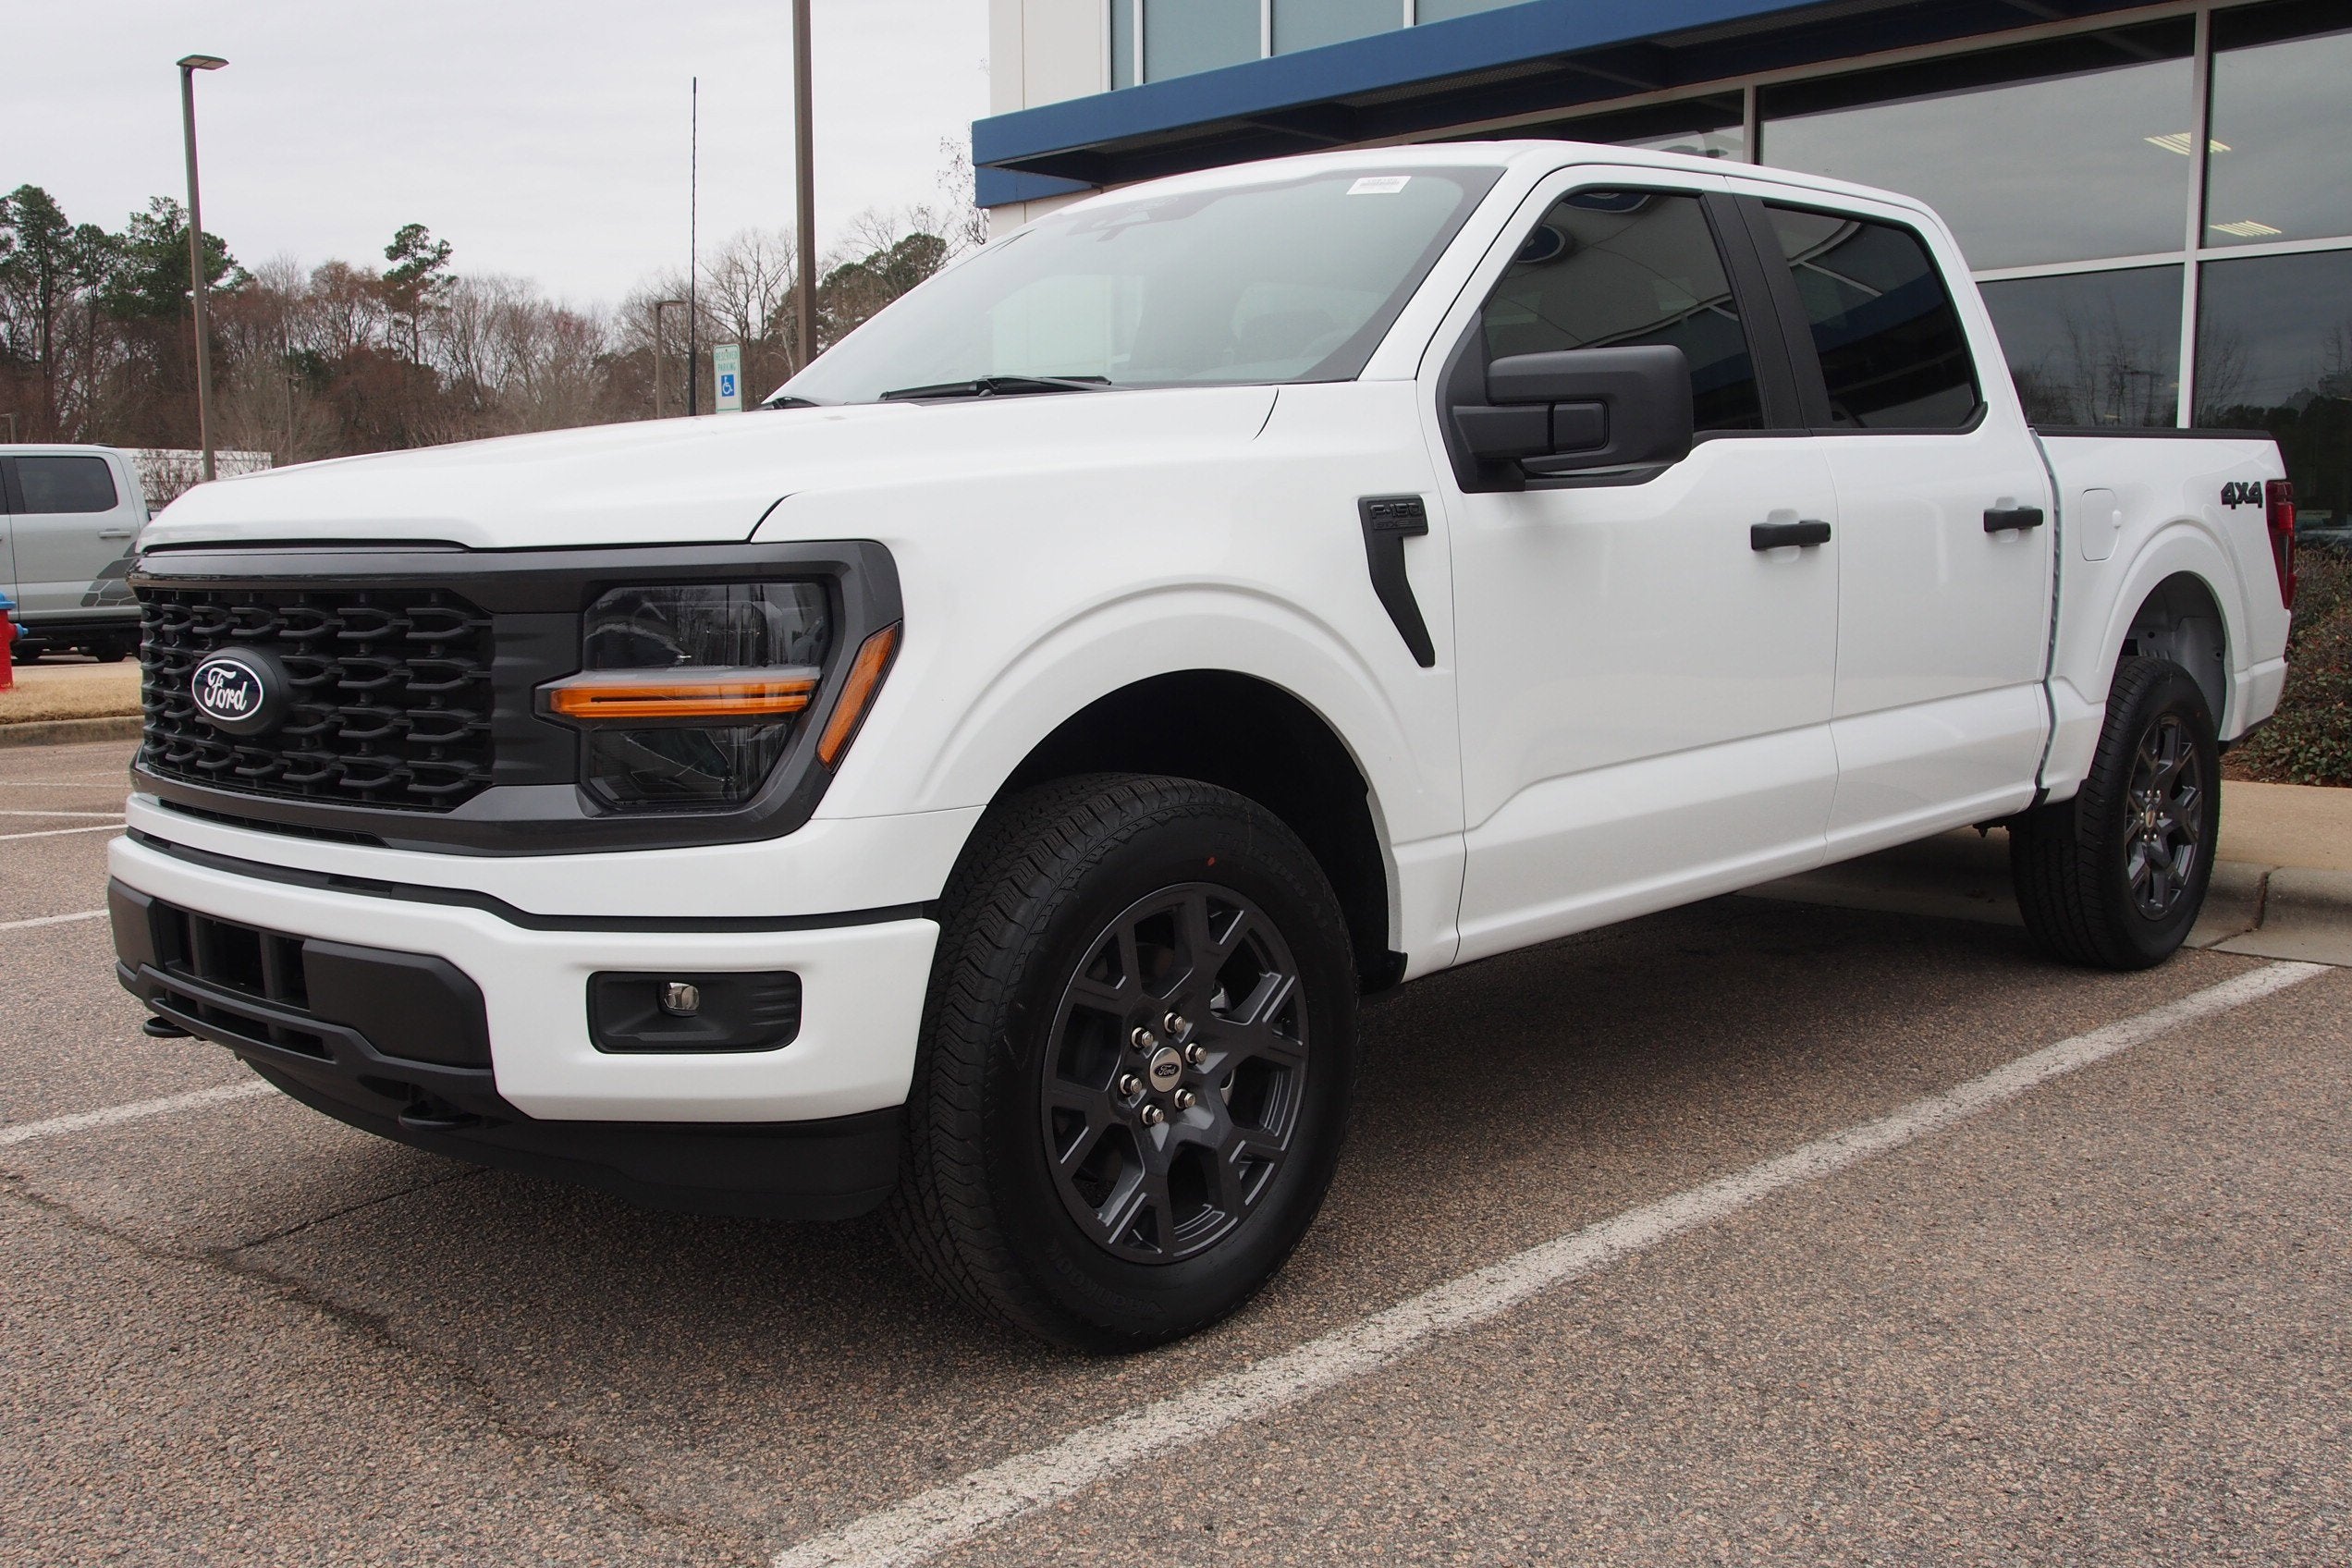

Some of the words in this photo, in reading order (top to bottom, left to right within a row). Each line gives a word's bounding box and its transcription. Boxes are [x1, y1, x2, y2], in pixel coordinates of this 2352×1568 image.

[715, 351, 739, 361] RESERVED
[717, 361, 736, 372] PARKING
[1370, 503, 1422, 518] F-150
[204, 668, 248, 711] Ford
[1158, 1064, 1176, 1076] Ford
